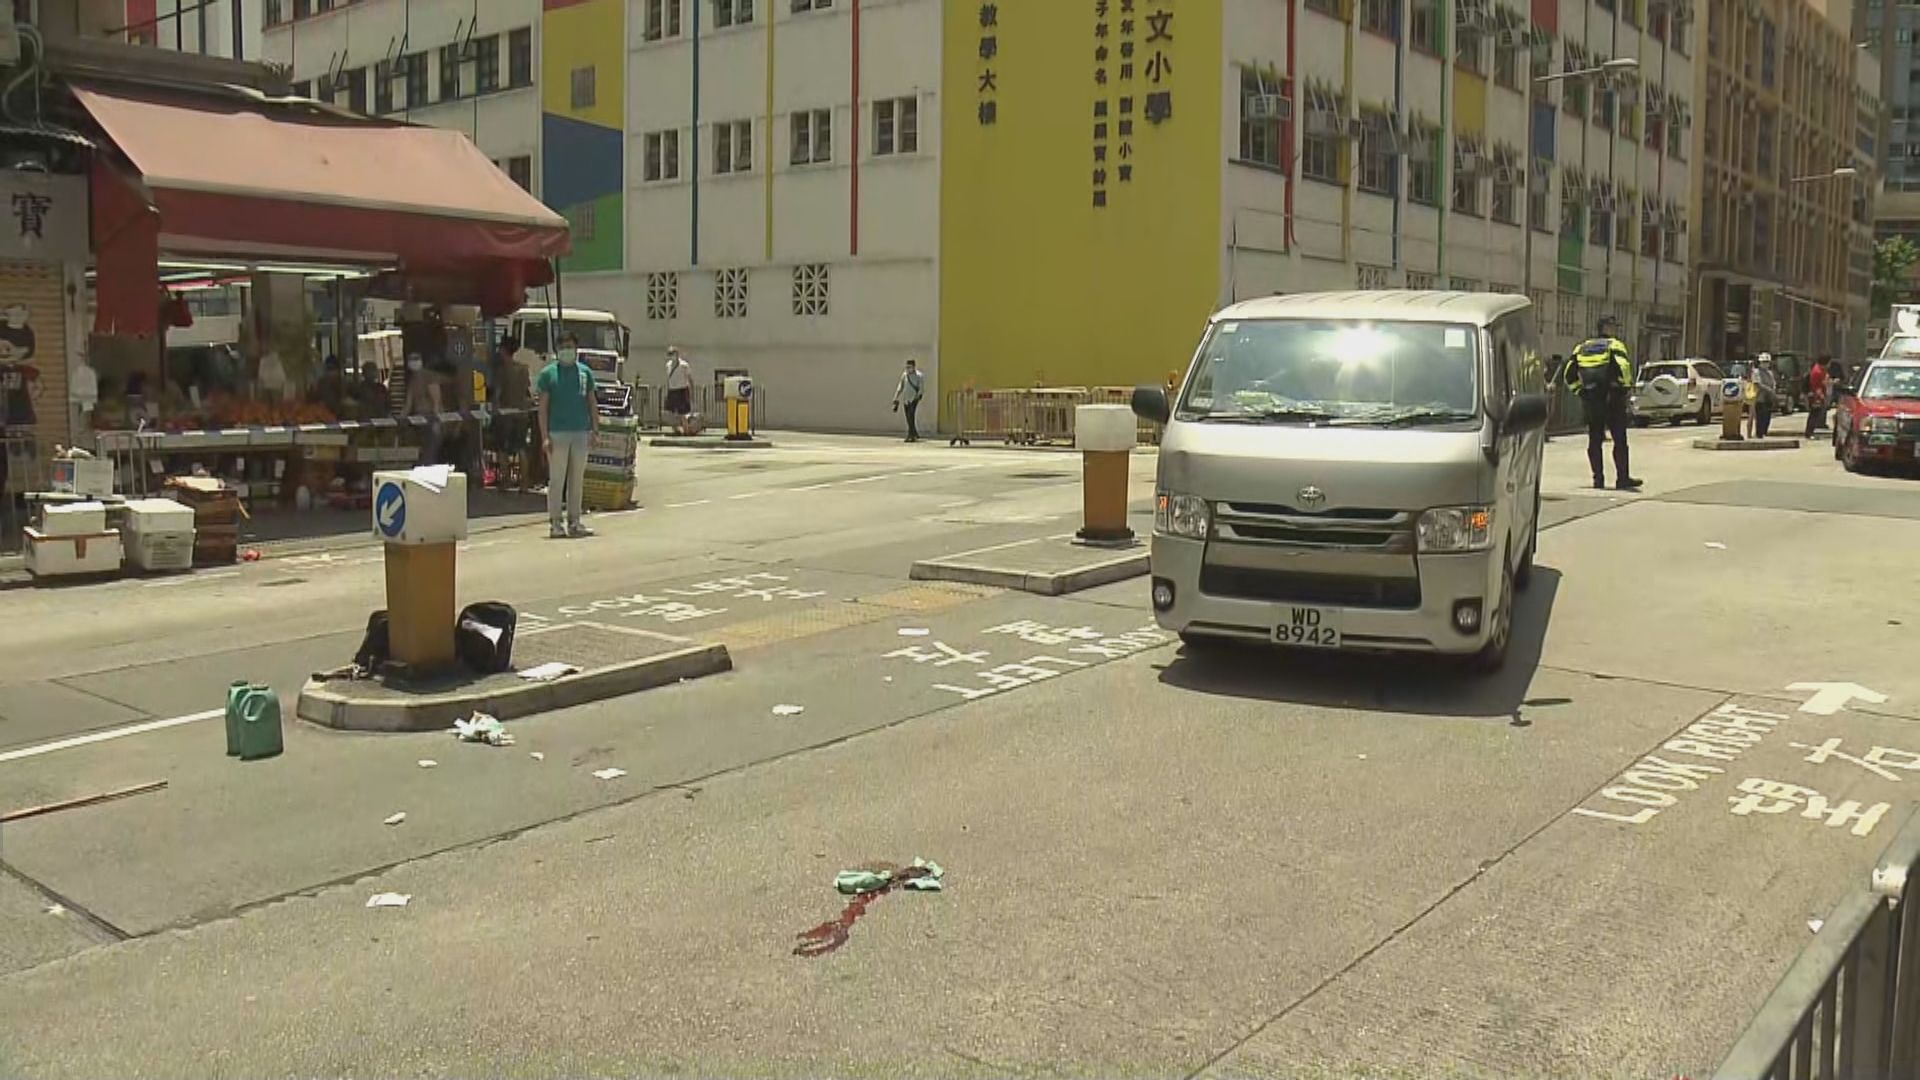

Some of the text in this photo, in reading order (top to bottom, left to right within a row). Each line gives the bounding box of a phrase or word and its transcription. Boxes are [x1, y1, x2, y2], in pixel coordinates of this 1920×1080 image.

[978, 3, 998, 126] 教學大樓
[1144, 0, 1174, 125] 文小學
[1275, 624, 1336, 645] 8942
[1291, 607, 1321, 626] WD
[932, 655, 1091, 700] LEFT
[1571, 702, 1791, 825] LOOK RIGHT
